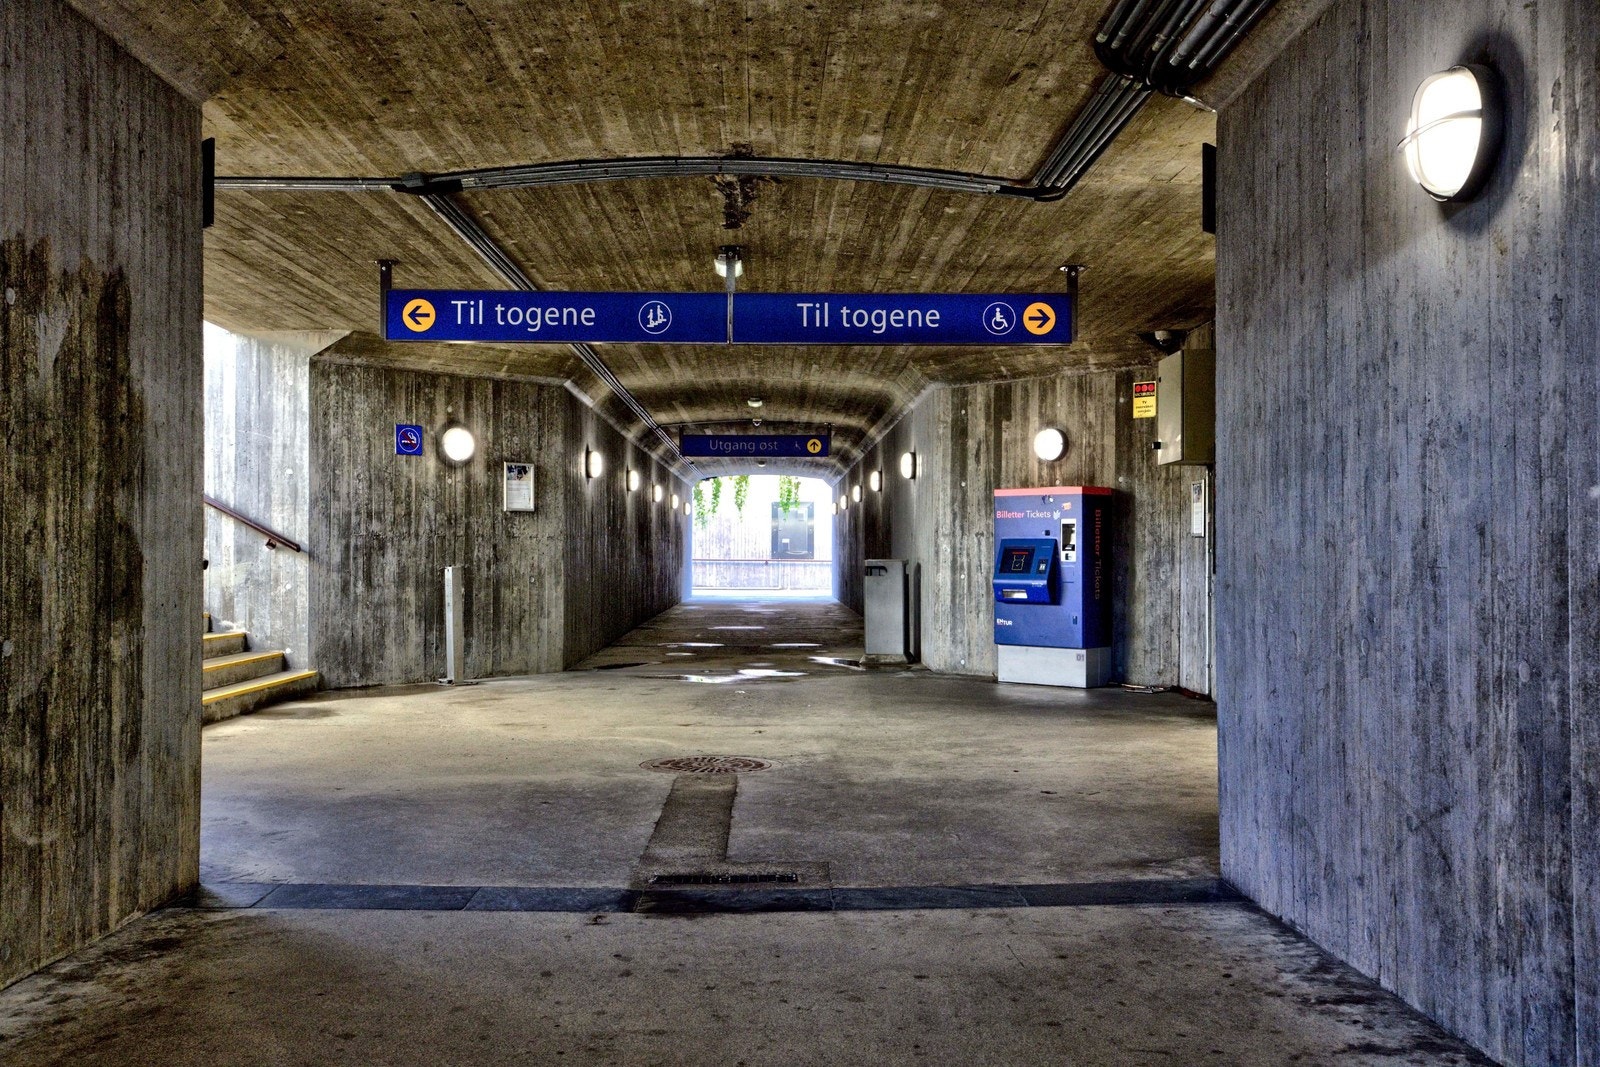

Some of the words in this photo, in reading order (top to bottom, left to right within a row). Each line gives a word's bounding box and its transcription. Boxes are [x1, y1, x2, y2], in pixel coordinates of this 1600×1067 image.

[451, 299, 483, 325] Til
[494, 303, 596, 332] togene
[796, 302, 829, 327] Til
[840, 305, 940, 334] togene
[709, 439, 755, 453] Utgang
[759, 440, 778, 450] øst
[996, 511, 1024, 519] Billetter
[1026, 510, 1051, 518] Tickets
[1094, 509, 1102, 556] Billetter
[1094, 559, 1102, 600] Tickets
[1076, 653, 1084, 662] 01
